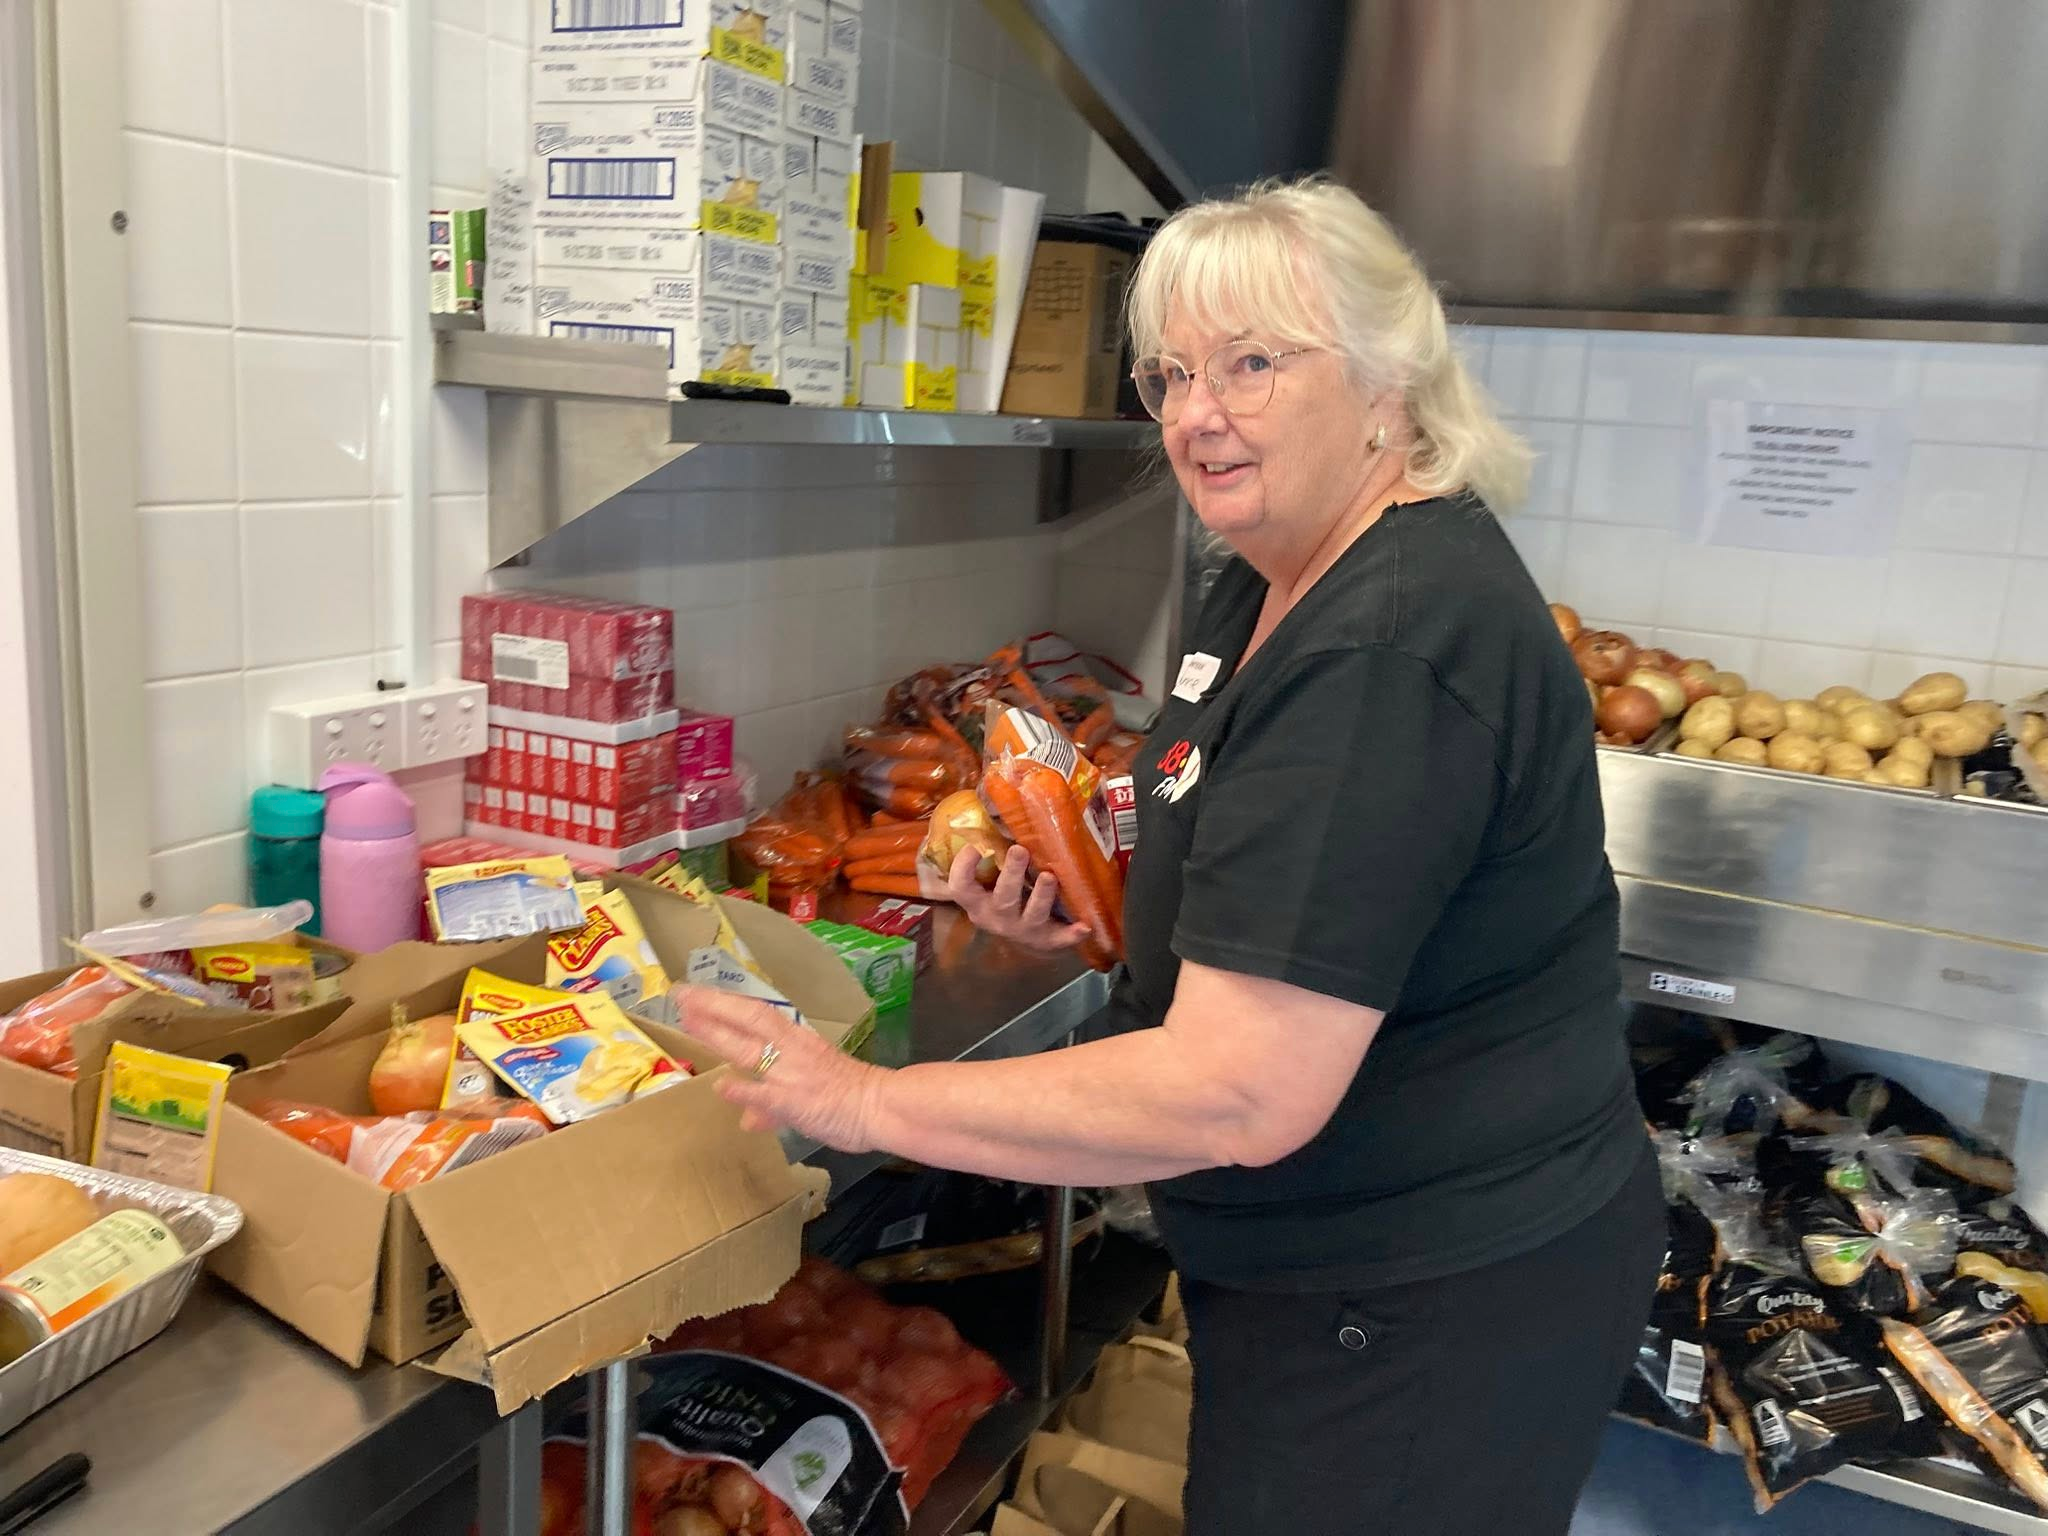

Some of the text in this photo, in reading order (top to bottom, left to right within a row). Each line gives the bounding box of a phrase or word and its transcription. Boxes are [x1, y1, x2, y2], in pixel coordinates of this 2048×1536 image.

[501, 1008, 578, 1040] FOSTER
[1756, 1293, 1827, 1315] Quality
[661, 1393, 766, 1438] Quality
